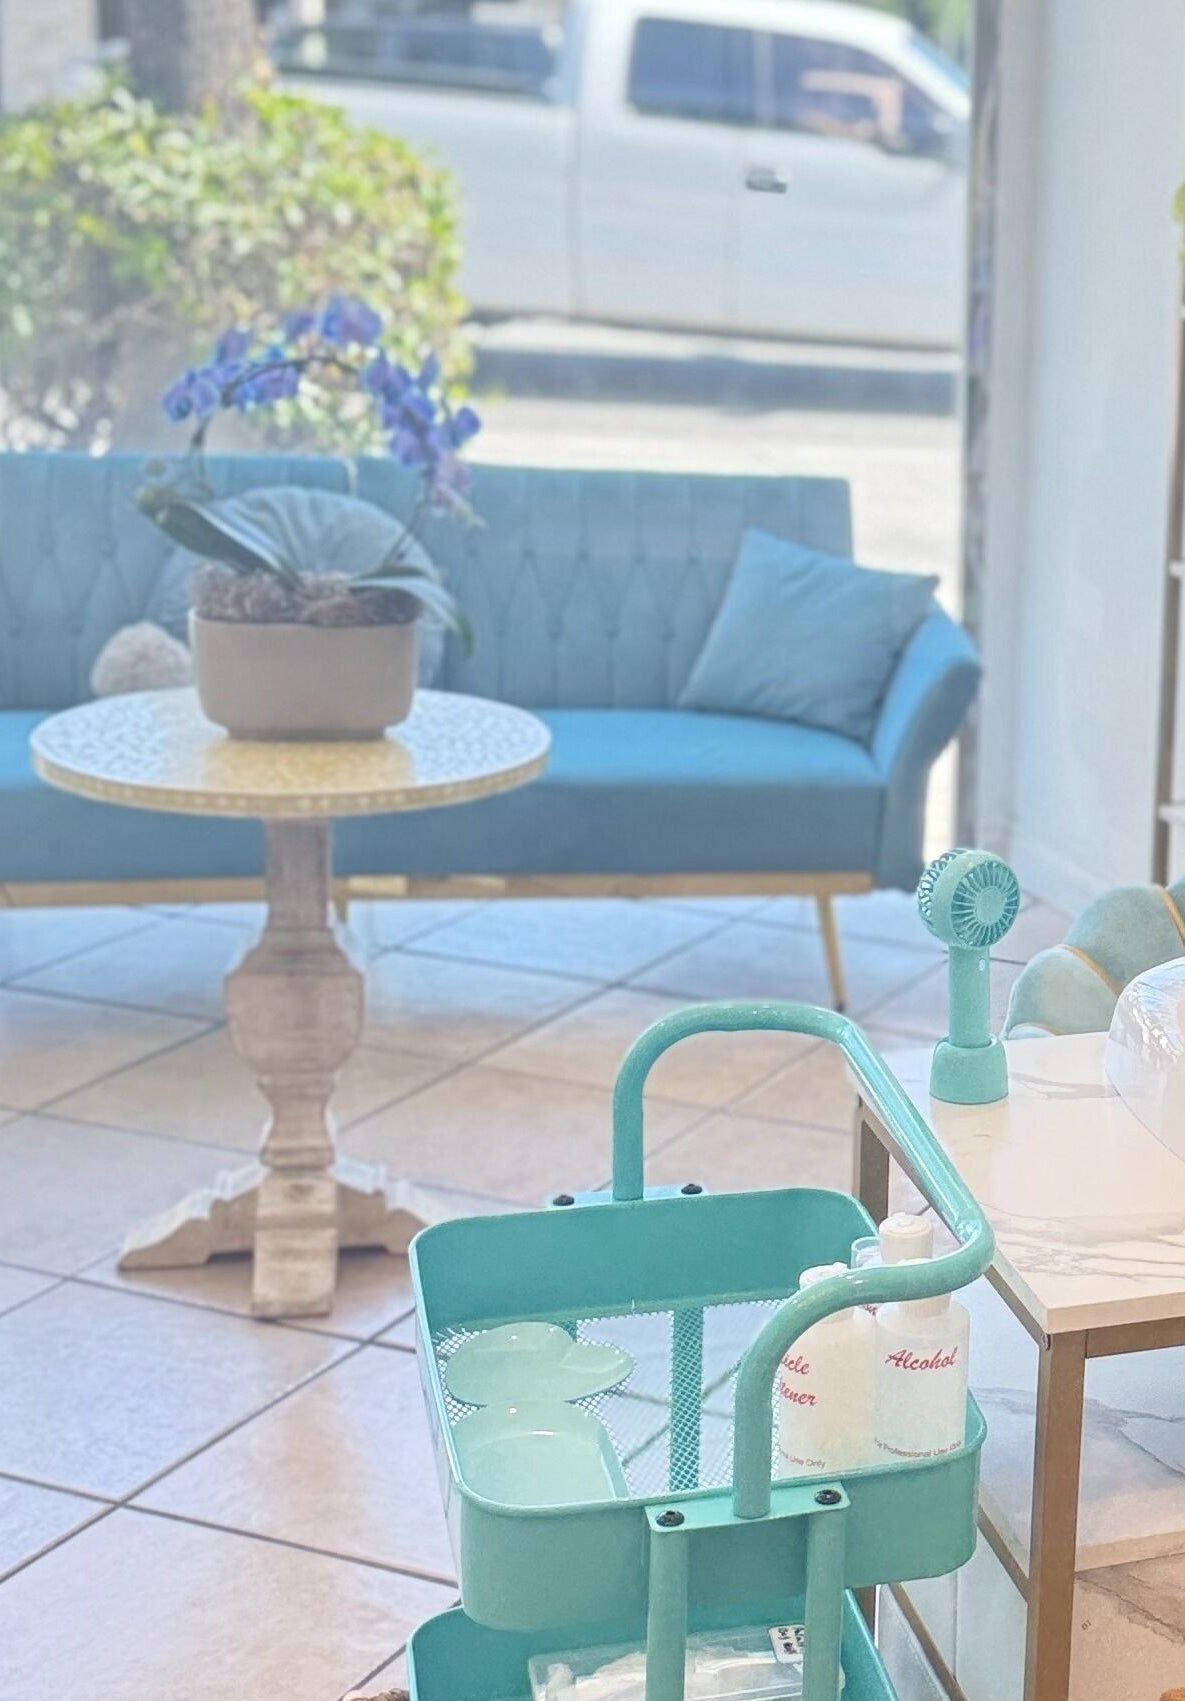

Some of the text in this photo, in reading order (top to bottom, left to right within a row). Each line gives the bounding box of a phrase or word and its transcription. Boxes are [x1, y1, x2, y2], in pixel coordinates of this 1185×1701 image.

[781, 1353, 810, 1375] icle
[884, 1345, 959, 1371] Alcohol
[779, 1377, 817, 1406] tener
